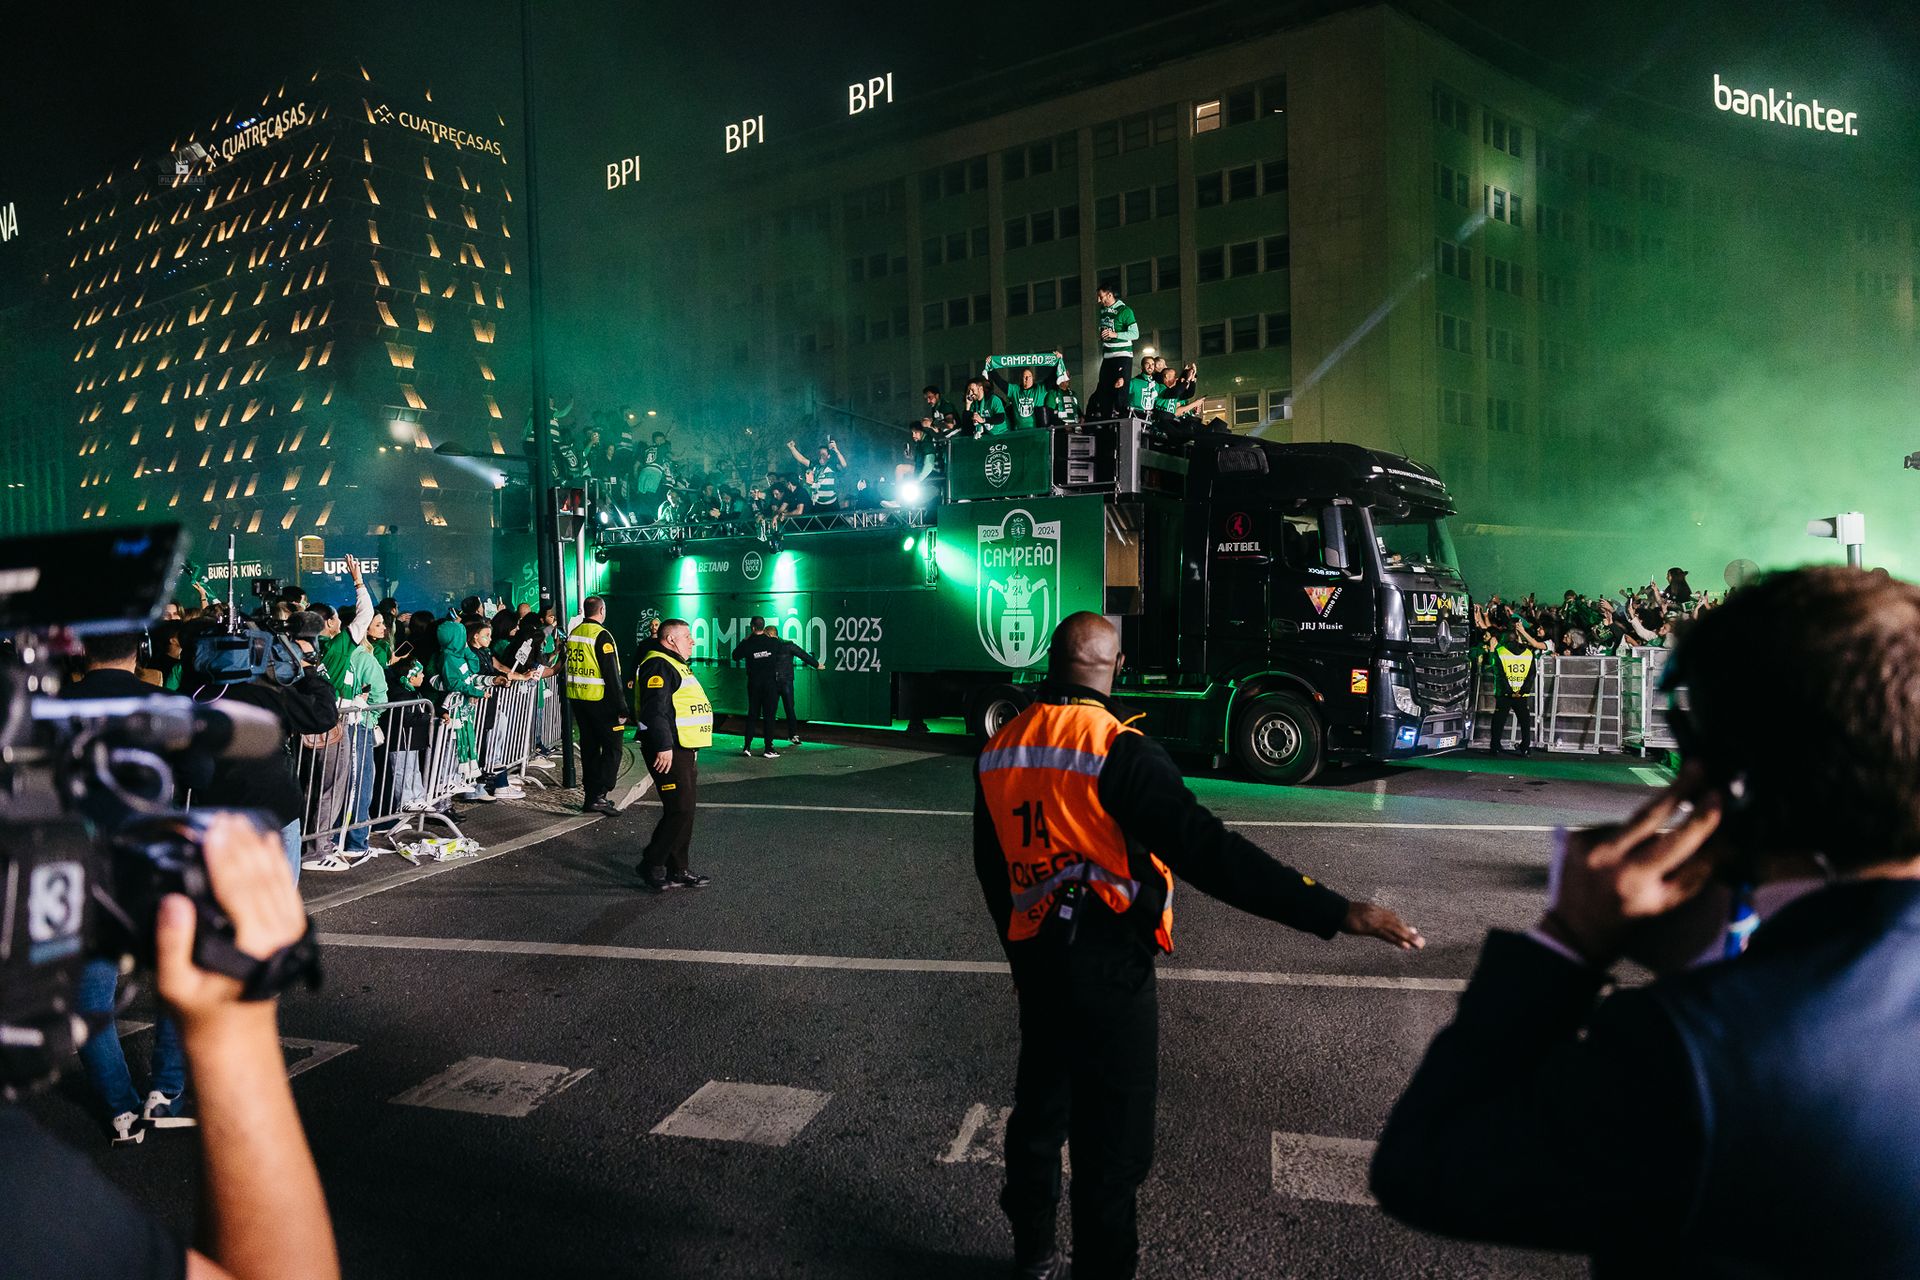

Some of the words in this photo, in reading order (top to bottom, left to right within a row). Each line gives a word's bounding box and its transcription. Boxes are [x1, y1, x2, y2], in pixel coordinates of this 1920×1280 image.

[849, 72, 893, 115] BPI
[222, 102, 306, 159] CUATRECASAS
[398, 111, 501, 155] CUATRECASAS
[725, 115, 764, 153] BPI
[607, 155, 641, 190] BPI
[1001, 354, 1044, 366] CAMPEÃO
[989, 444, 1008, 453] SCP
[982, 529, 999, 538] 2023
[1037, 526, 1055, 535] 2024
[983, 542, 1053, 567] CAMPEÃO
[1217, 541, 1261, 552] ARTBEL
[241, 563, 262, 577] KING
[698, 561, 729, 573] BETANO
[834, 616, 883, 641] 2023
[1300, 622, 1316, 631] JRJ
[1318, 622, 1343, 630] Music
[568, 648, 584, 662] 235
[834, 646, 882, 672] 2024
[1507, 664, 1526, 673] 183
[1012, 800, 1051, 849] 14
[45, 871, 71, 931] 3
